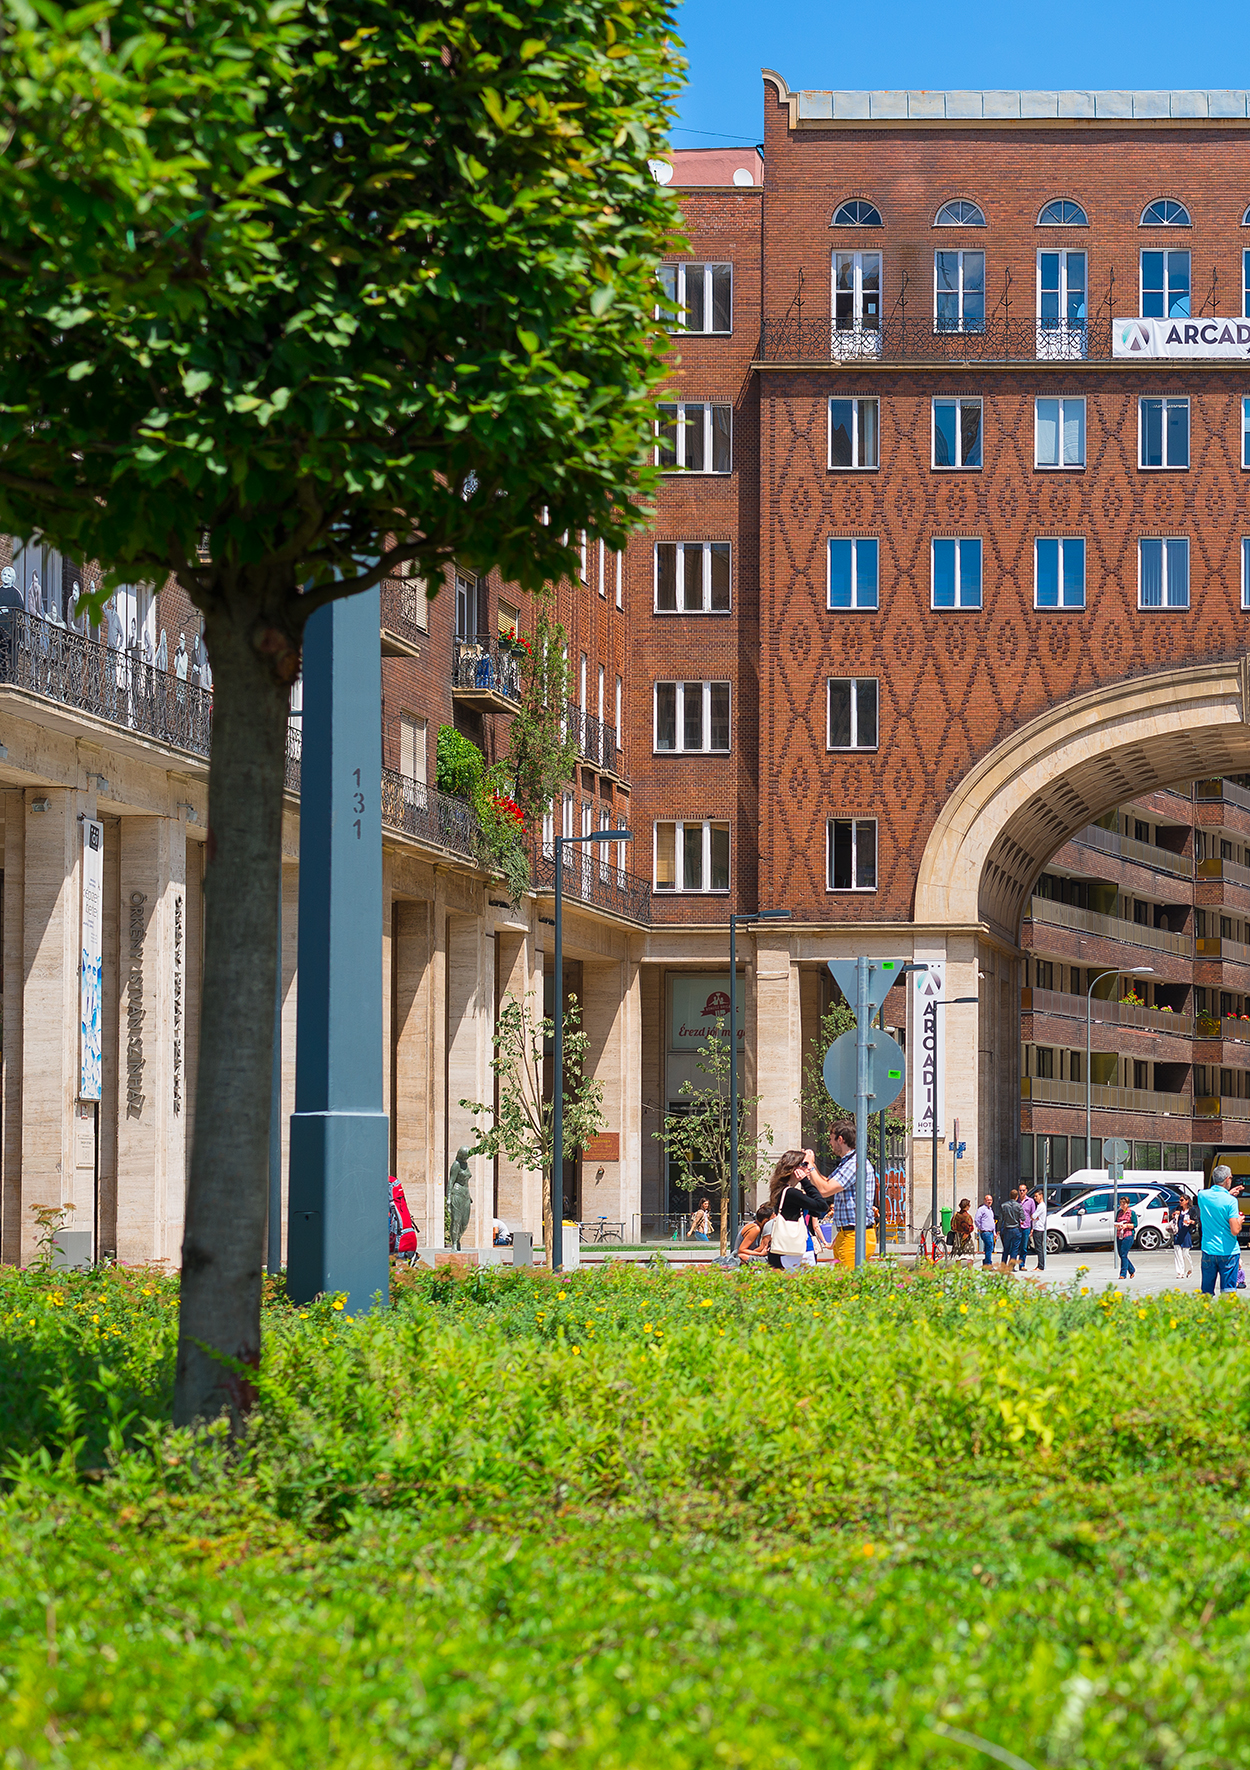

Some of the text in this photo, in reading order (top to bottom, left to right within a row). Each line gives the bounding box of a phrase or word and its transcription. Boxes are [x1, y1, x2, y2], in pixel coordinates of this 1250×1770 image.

[352, 767, 365, 840] 131
[126, 891, 148, 1120] ÖRKÉNY ISTVÁN SZÍNHÁZ
[678, 1023, 706, 1037] Érezd
[704, 1026, 718, 1040] jó
